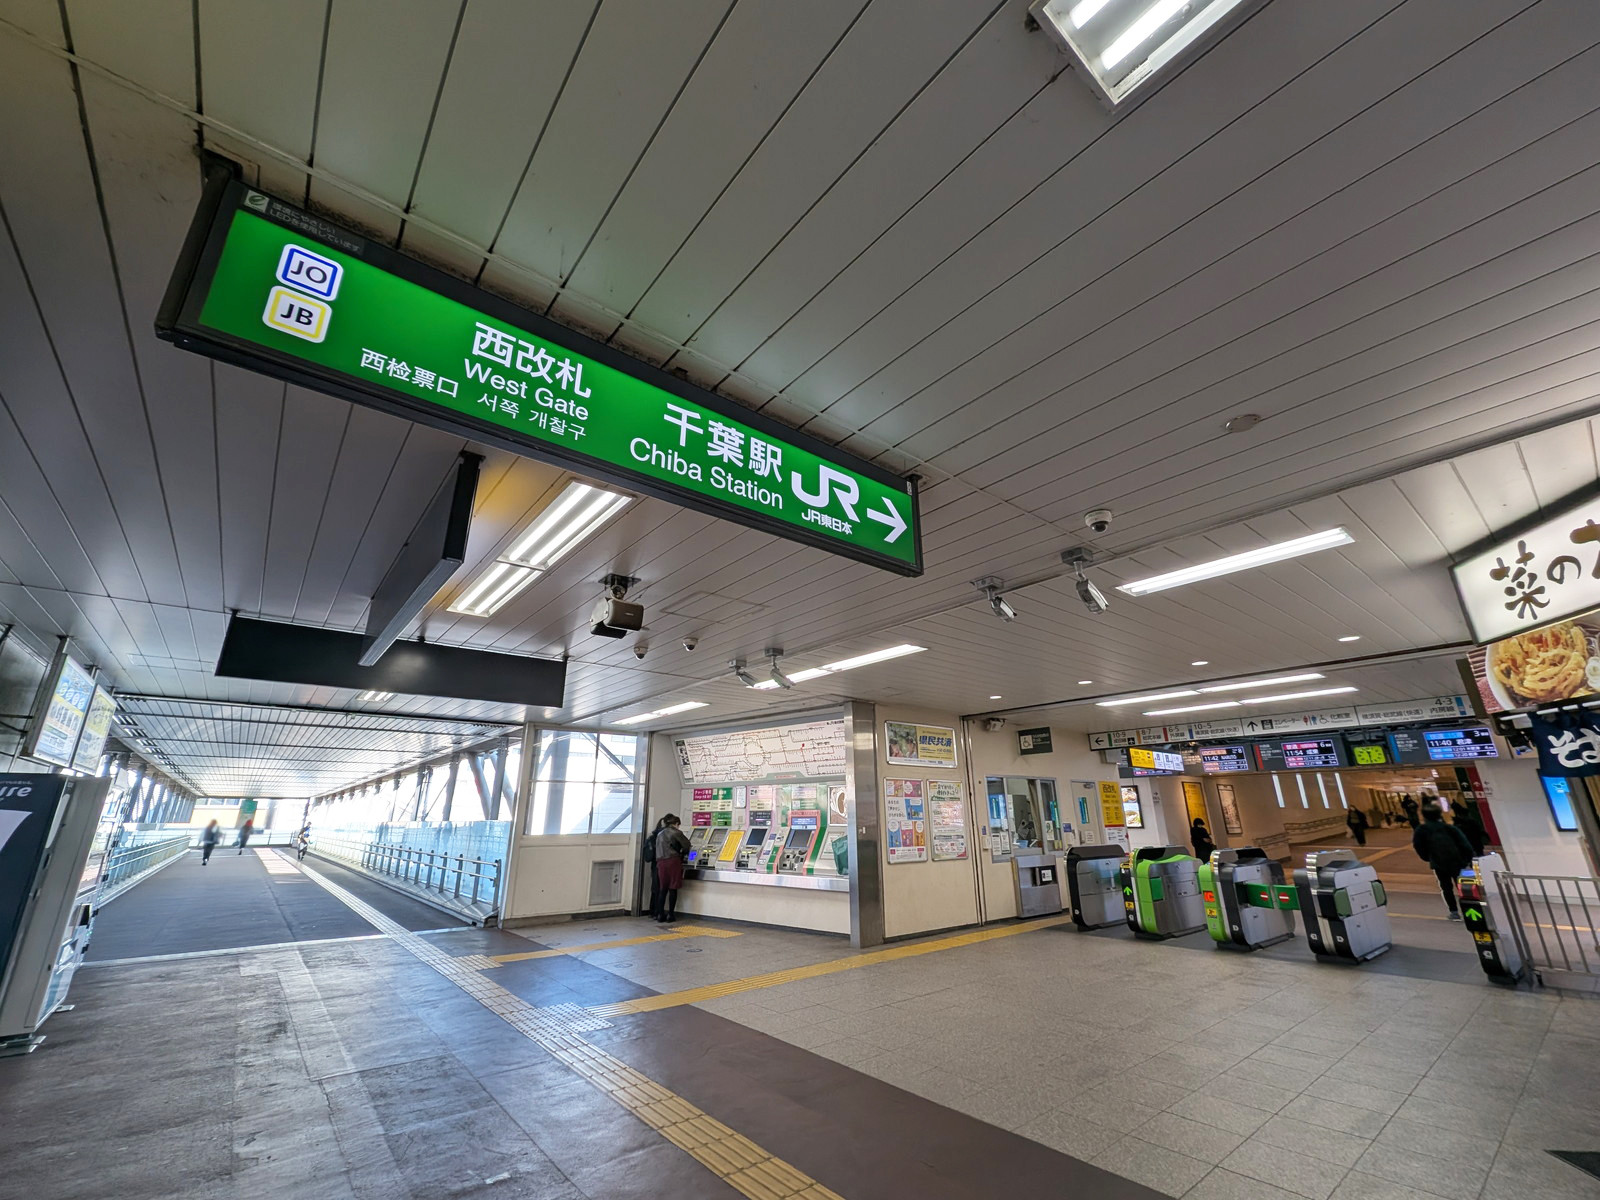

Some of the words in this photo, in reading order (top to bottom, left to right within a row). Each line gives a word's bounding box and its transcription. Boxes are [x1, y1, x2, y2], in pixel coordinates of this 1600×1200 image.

[290, 260, 328, 285] JO
[280, 302, 314, 327] JB
[359, 347, 460, 398] 西检票口
[472, 321, 592, 399] 西改札
[464, 358, 528, 399] West
[534, 387, 589, 421] Gate
[477, 393, 520, 419] 서쪽
[528, 409, 586, 440] 개찰구
[663, 402, 783, 483] 千葉駅
[629, 437, 703, 482] Chiba
[709, 466, 784, 510] Station
[791, 464, 861, 523] JR
[801, 508, 853, 536] JR東日本
[1430, 739, 1452, 747] 11:40
